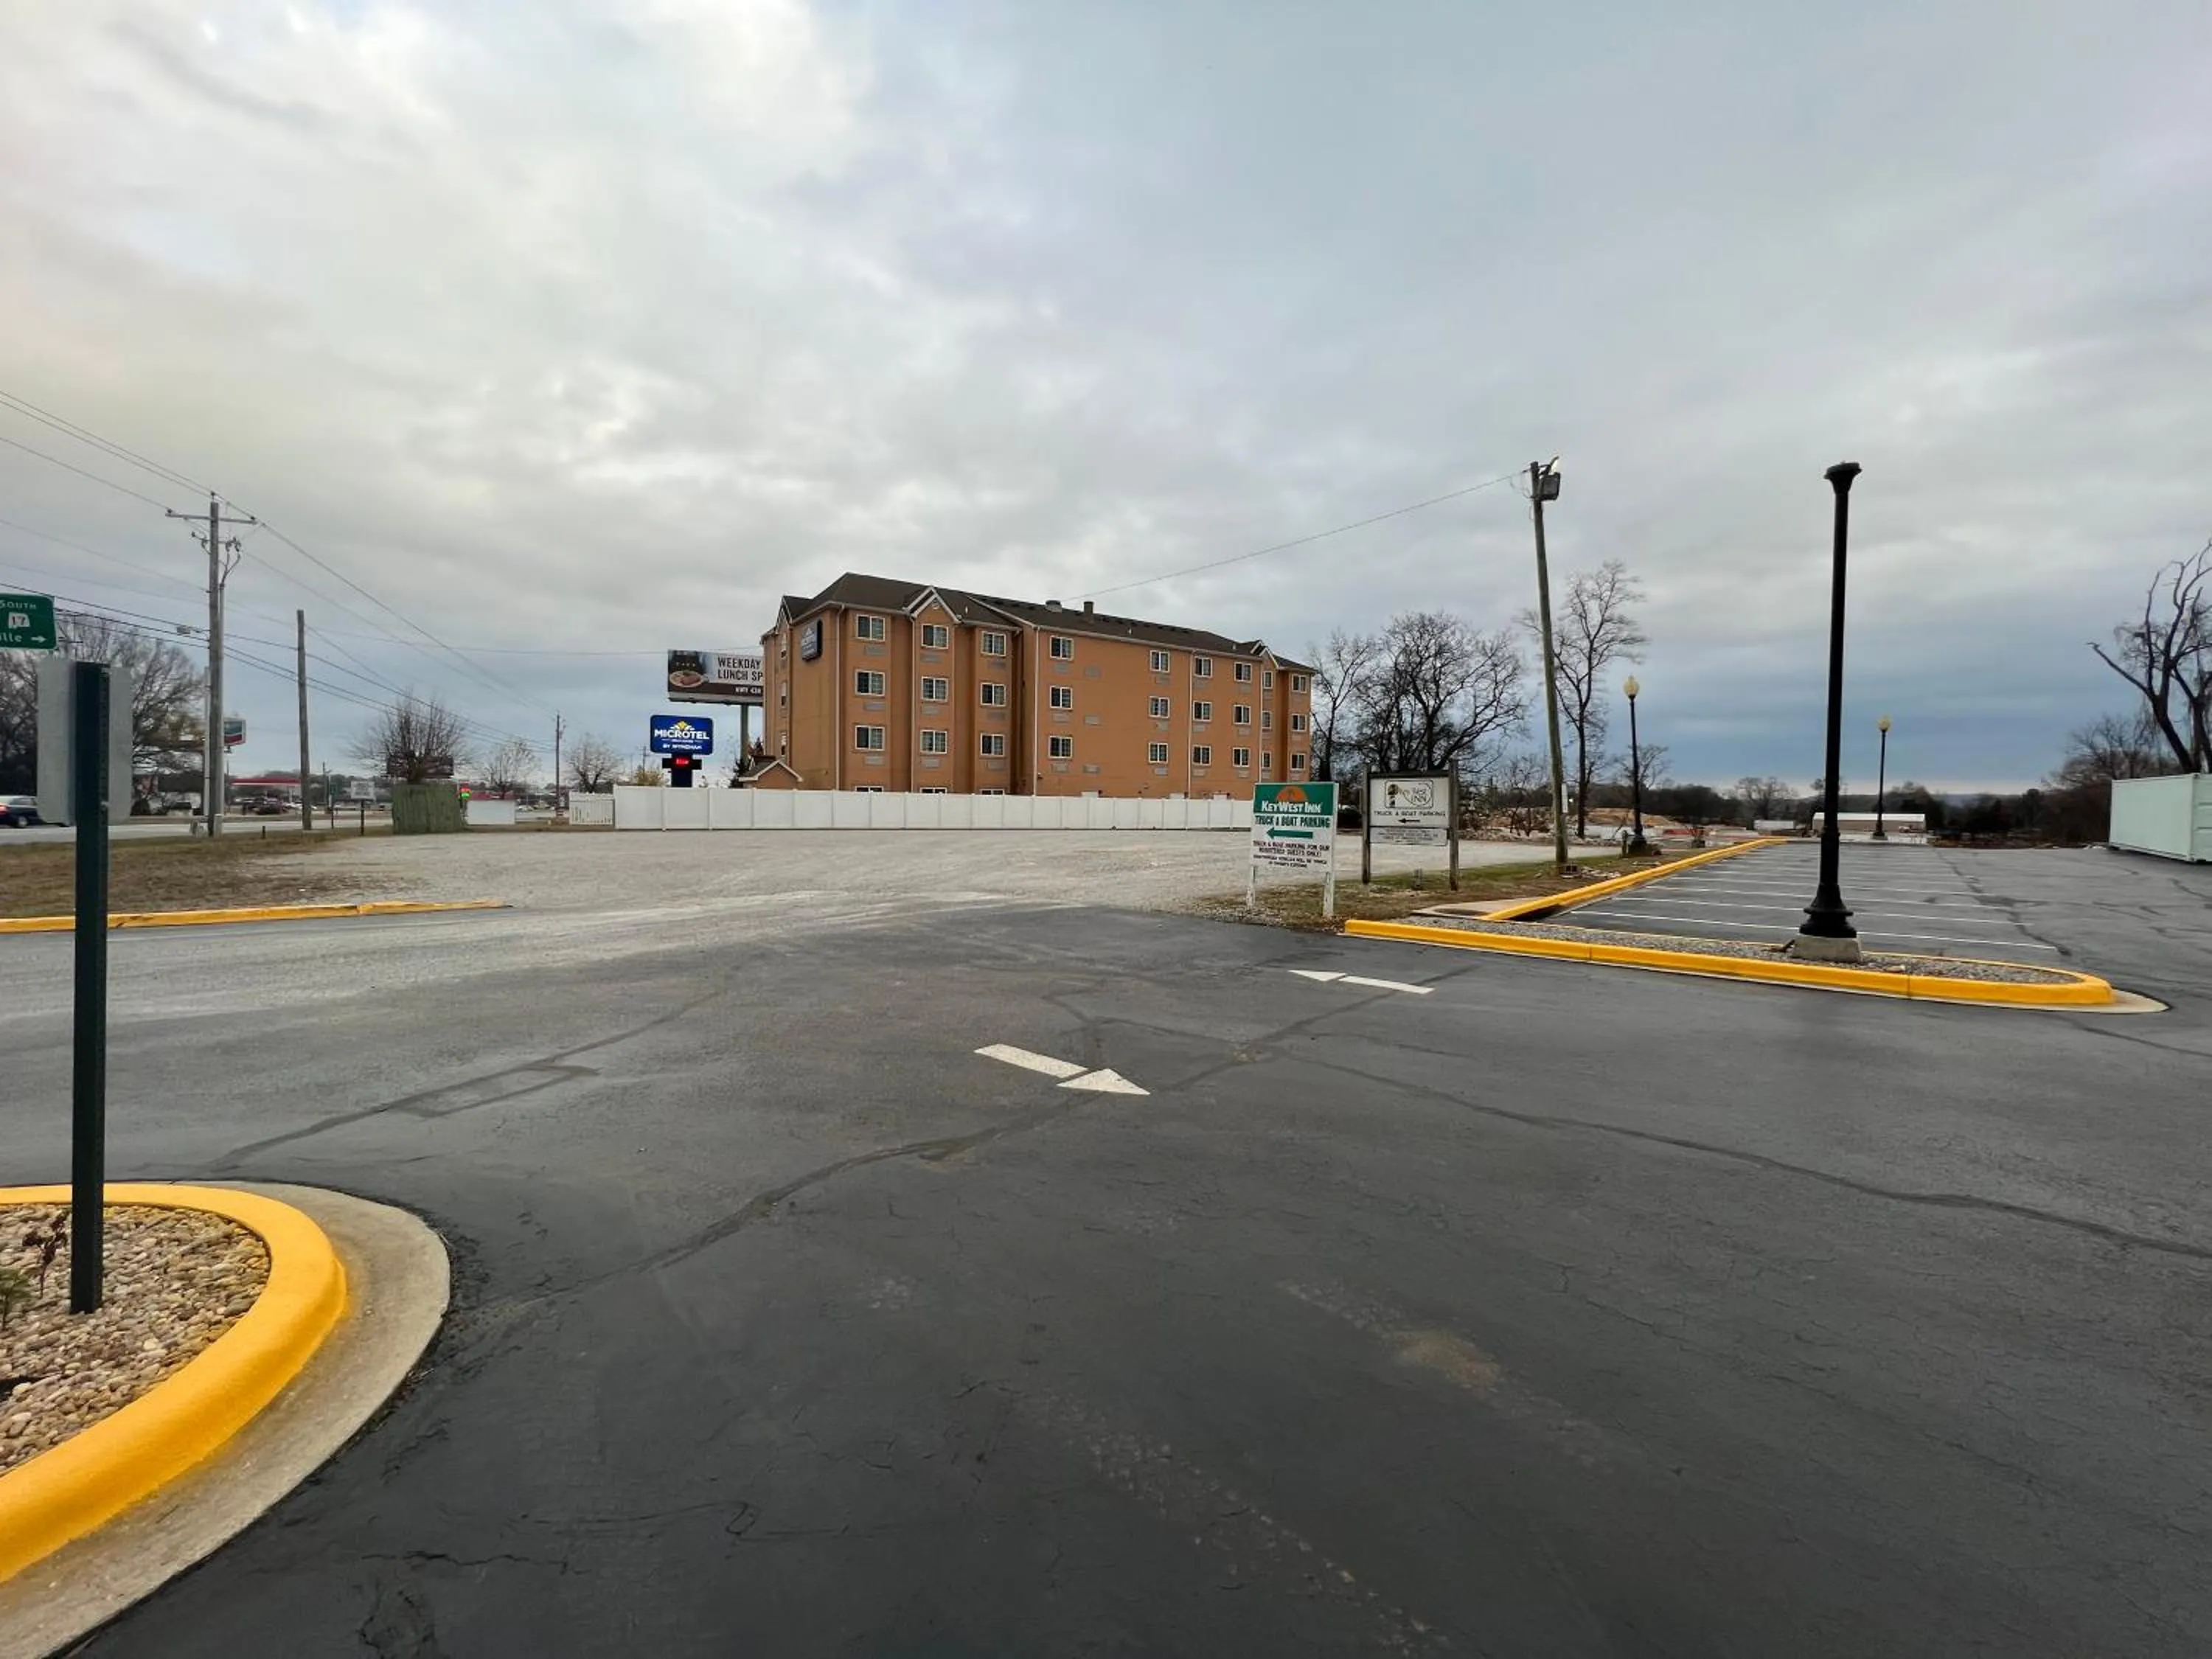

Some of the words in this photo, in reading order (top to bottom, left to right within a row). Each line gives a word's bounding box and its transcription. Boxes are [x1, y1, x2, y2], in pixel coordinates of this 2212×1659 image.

[717, 657, 761, 669] WEEKDAY
[717, 669, 748, 681] LUNCH
[654, 729, 710, 740] MICROTEL
[1255, 815, 1274, 825] TRUCK
[1281, 815, 1298, 827] BOAT
[1301, 816, 1331, 828] PARKING
